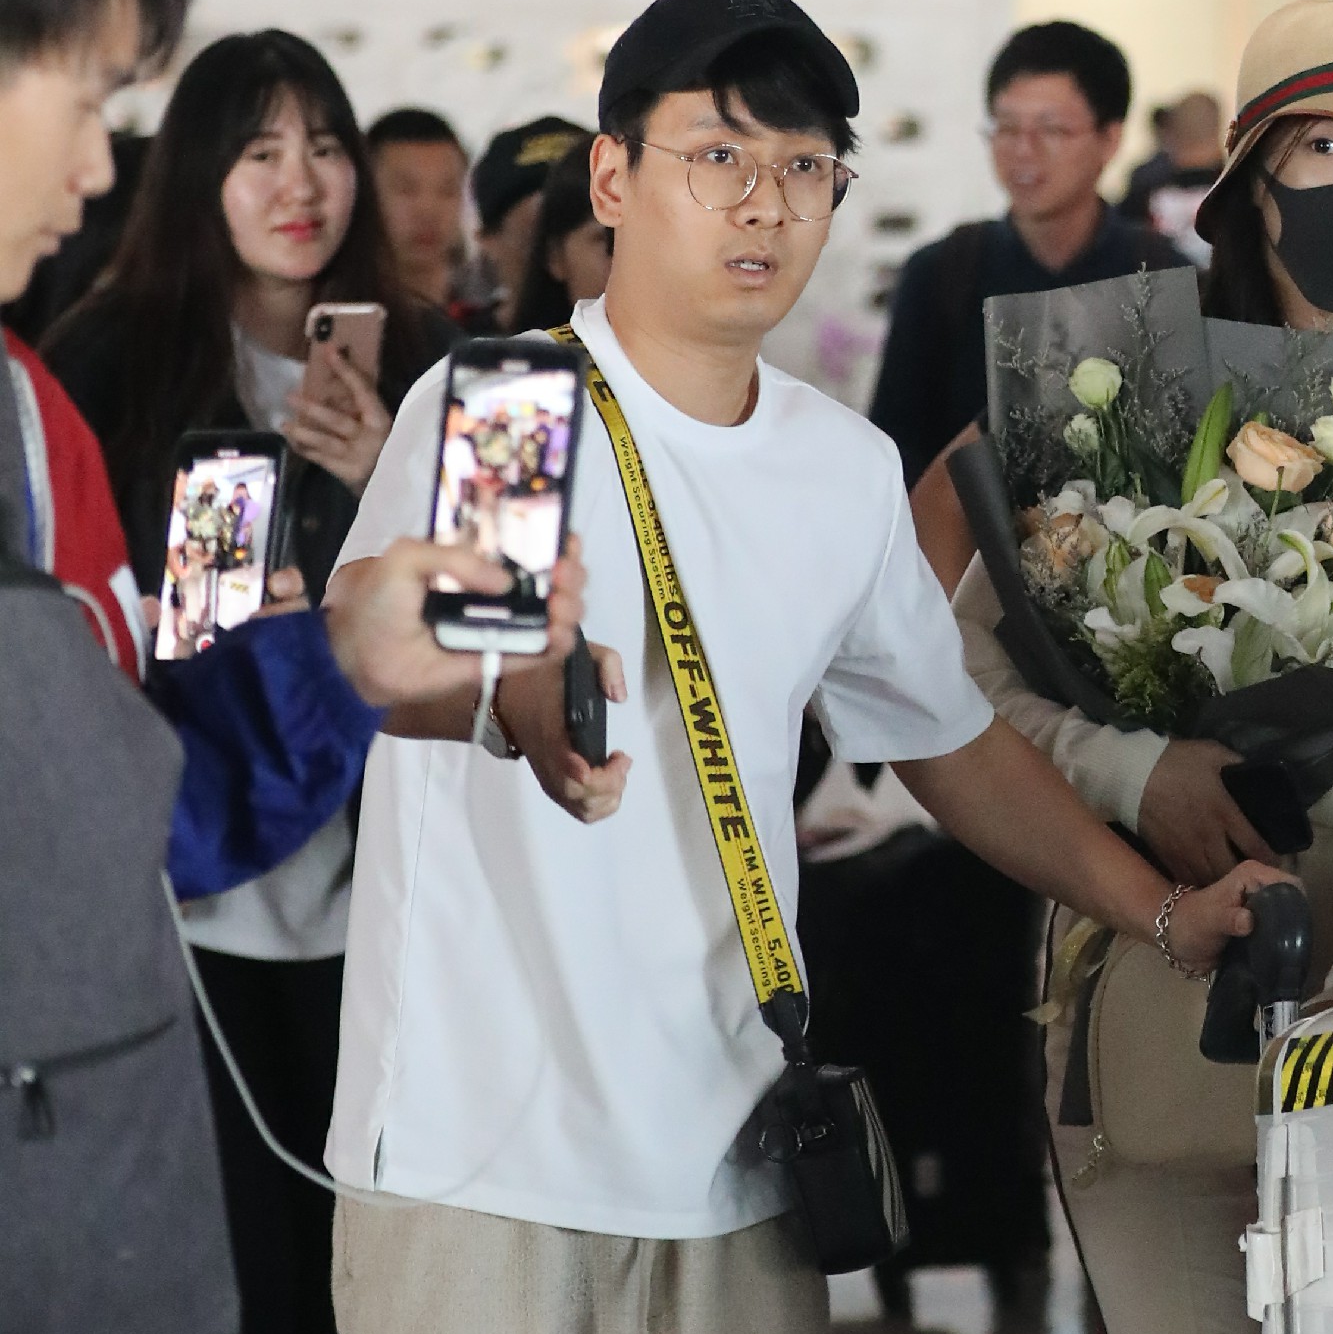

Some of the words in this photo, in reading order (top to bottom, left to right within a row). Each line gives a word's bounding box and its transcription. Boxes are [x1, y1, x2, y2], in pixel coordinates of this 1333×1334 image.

[619, 435, 638, 483] Weight
[632, 486, 652, 545] Securing
[648, 548, 666, 600] System
[663, 601, 750, 842] OFF-WHITE
[737, 878, 756, 925] Weight
[750, 927, 772, 988] Securing
[743, 845, 759, 873] TM
[752, 877, 774, 930] WILL
